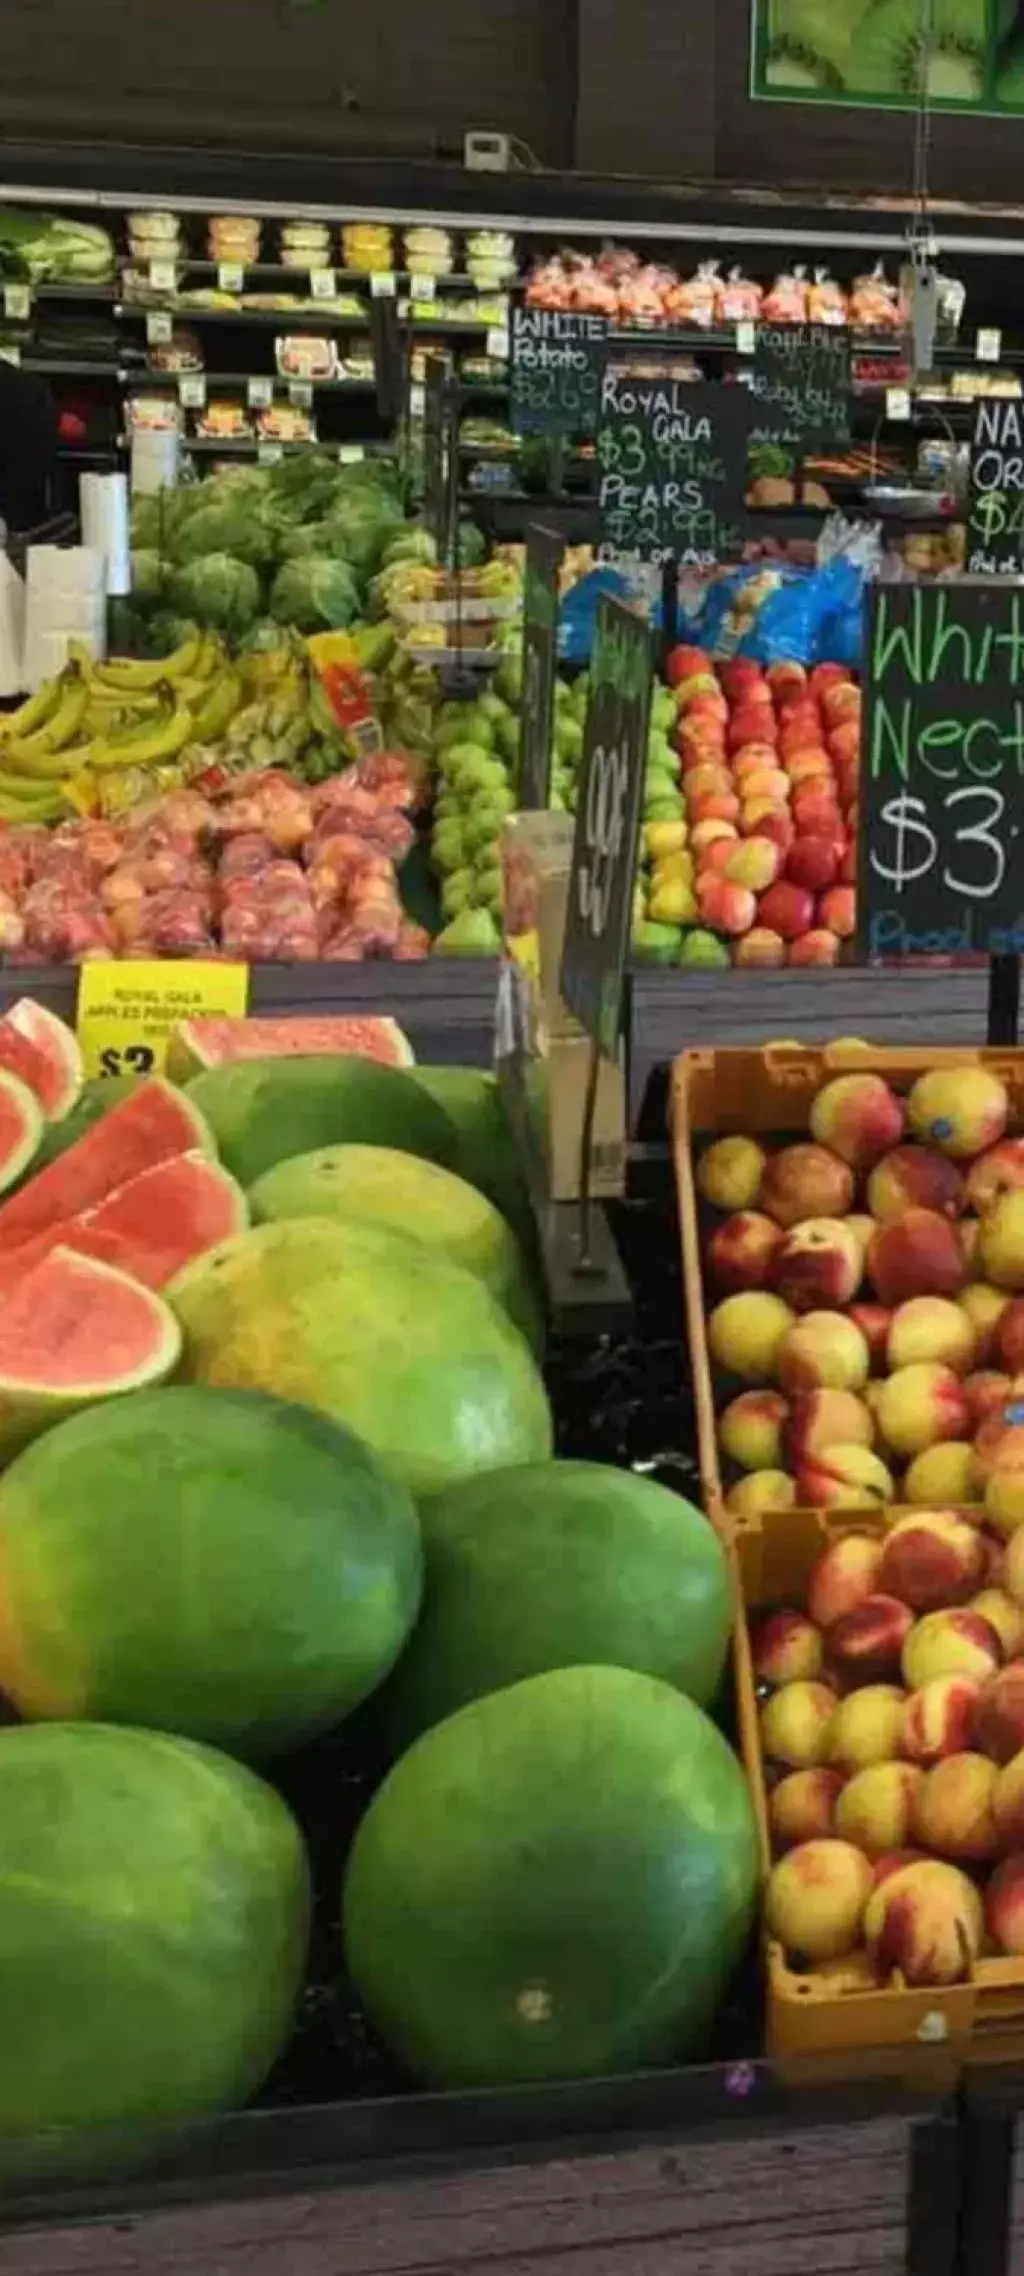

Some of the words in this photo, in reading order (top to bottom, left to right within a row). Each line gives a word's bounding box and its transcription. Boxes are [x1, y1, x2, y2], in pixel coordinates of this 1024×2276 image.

[513, 309, 605, 340] WHITE
[513, 338, 589, 370] Potato
[601, 373, 687, 416] ROYAL
[652, 413, 712, 443] GALA
[974, 401, 1024, 448] NA
[600, 474, 703, 511] PEARS
[873, 587, 1024, 685] Whit
